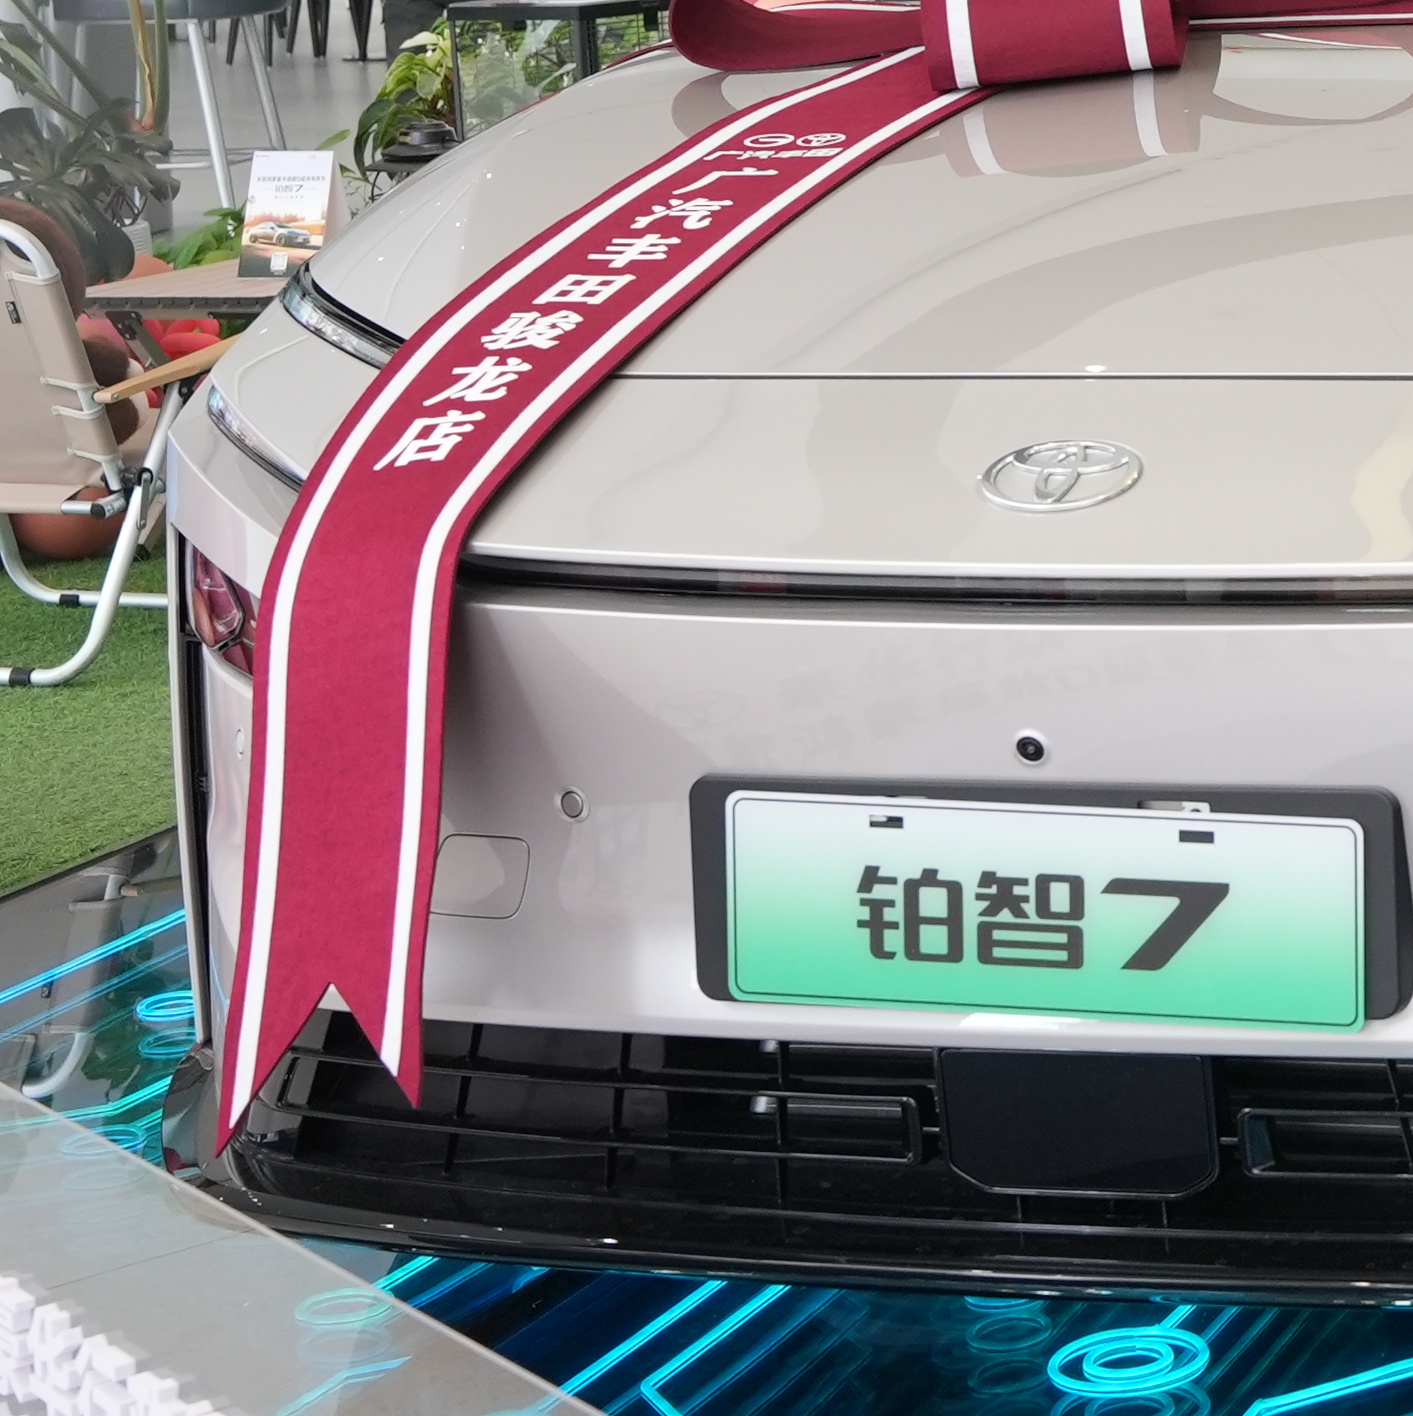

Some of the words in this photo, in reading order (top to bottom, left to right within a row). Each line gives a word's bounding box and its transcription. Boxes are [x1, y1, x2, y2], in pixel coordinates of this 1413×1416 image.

[373, 167, 778, 471] 广汽丰田骏龙店
[856, 865, 1231, 972] 铂智7
